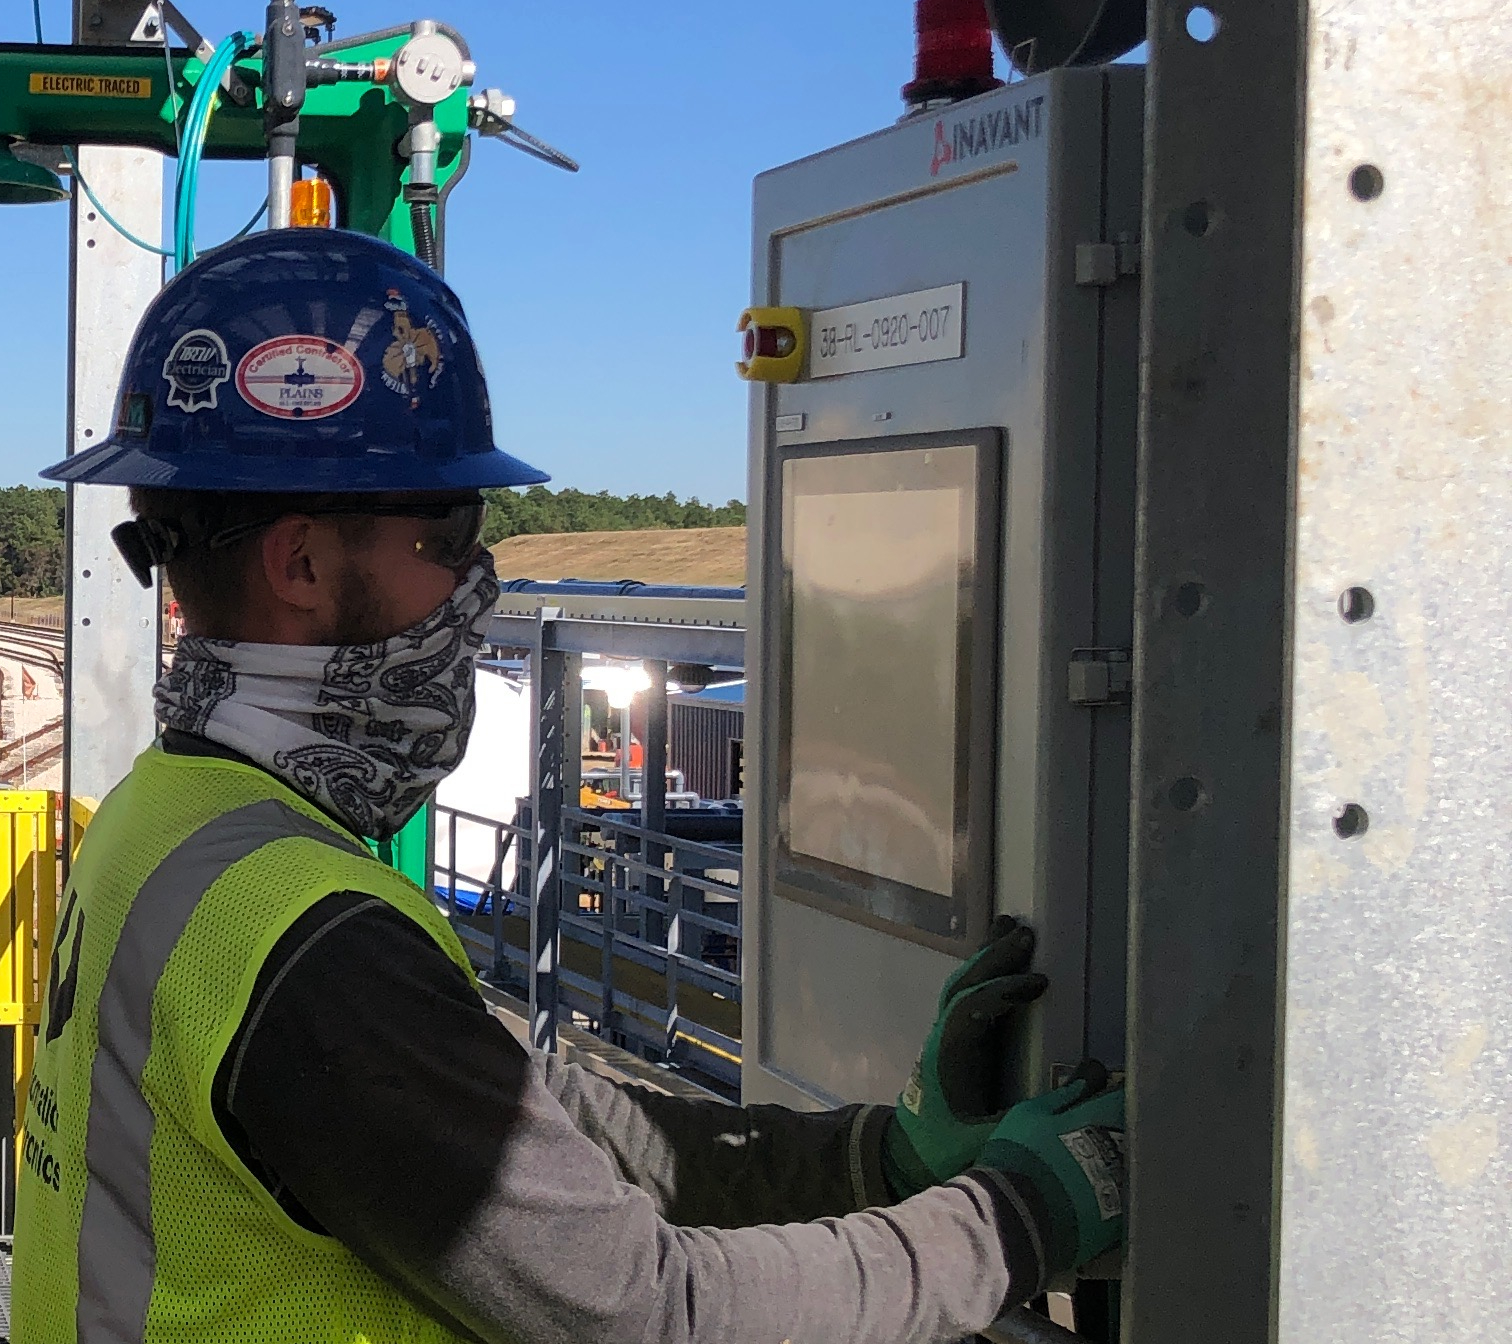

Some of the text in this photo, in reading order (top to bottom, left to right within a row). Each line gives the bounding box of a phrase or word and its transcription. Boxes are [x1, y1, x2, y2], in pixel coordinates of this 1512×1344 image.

[42, 76, 140, 94] ELECTRIC TRACED
[820, 305, 951, 358] 38-RL-0920-007
[279, 388, 323, 399] PLAINS
